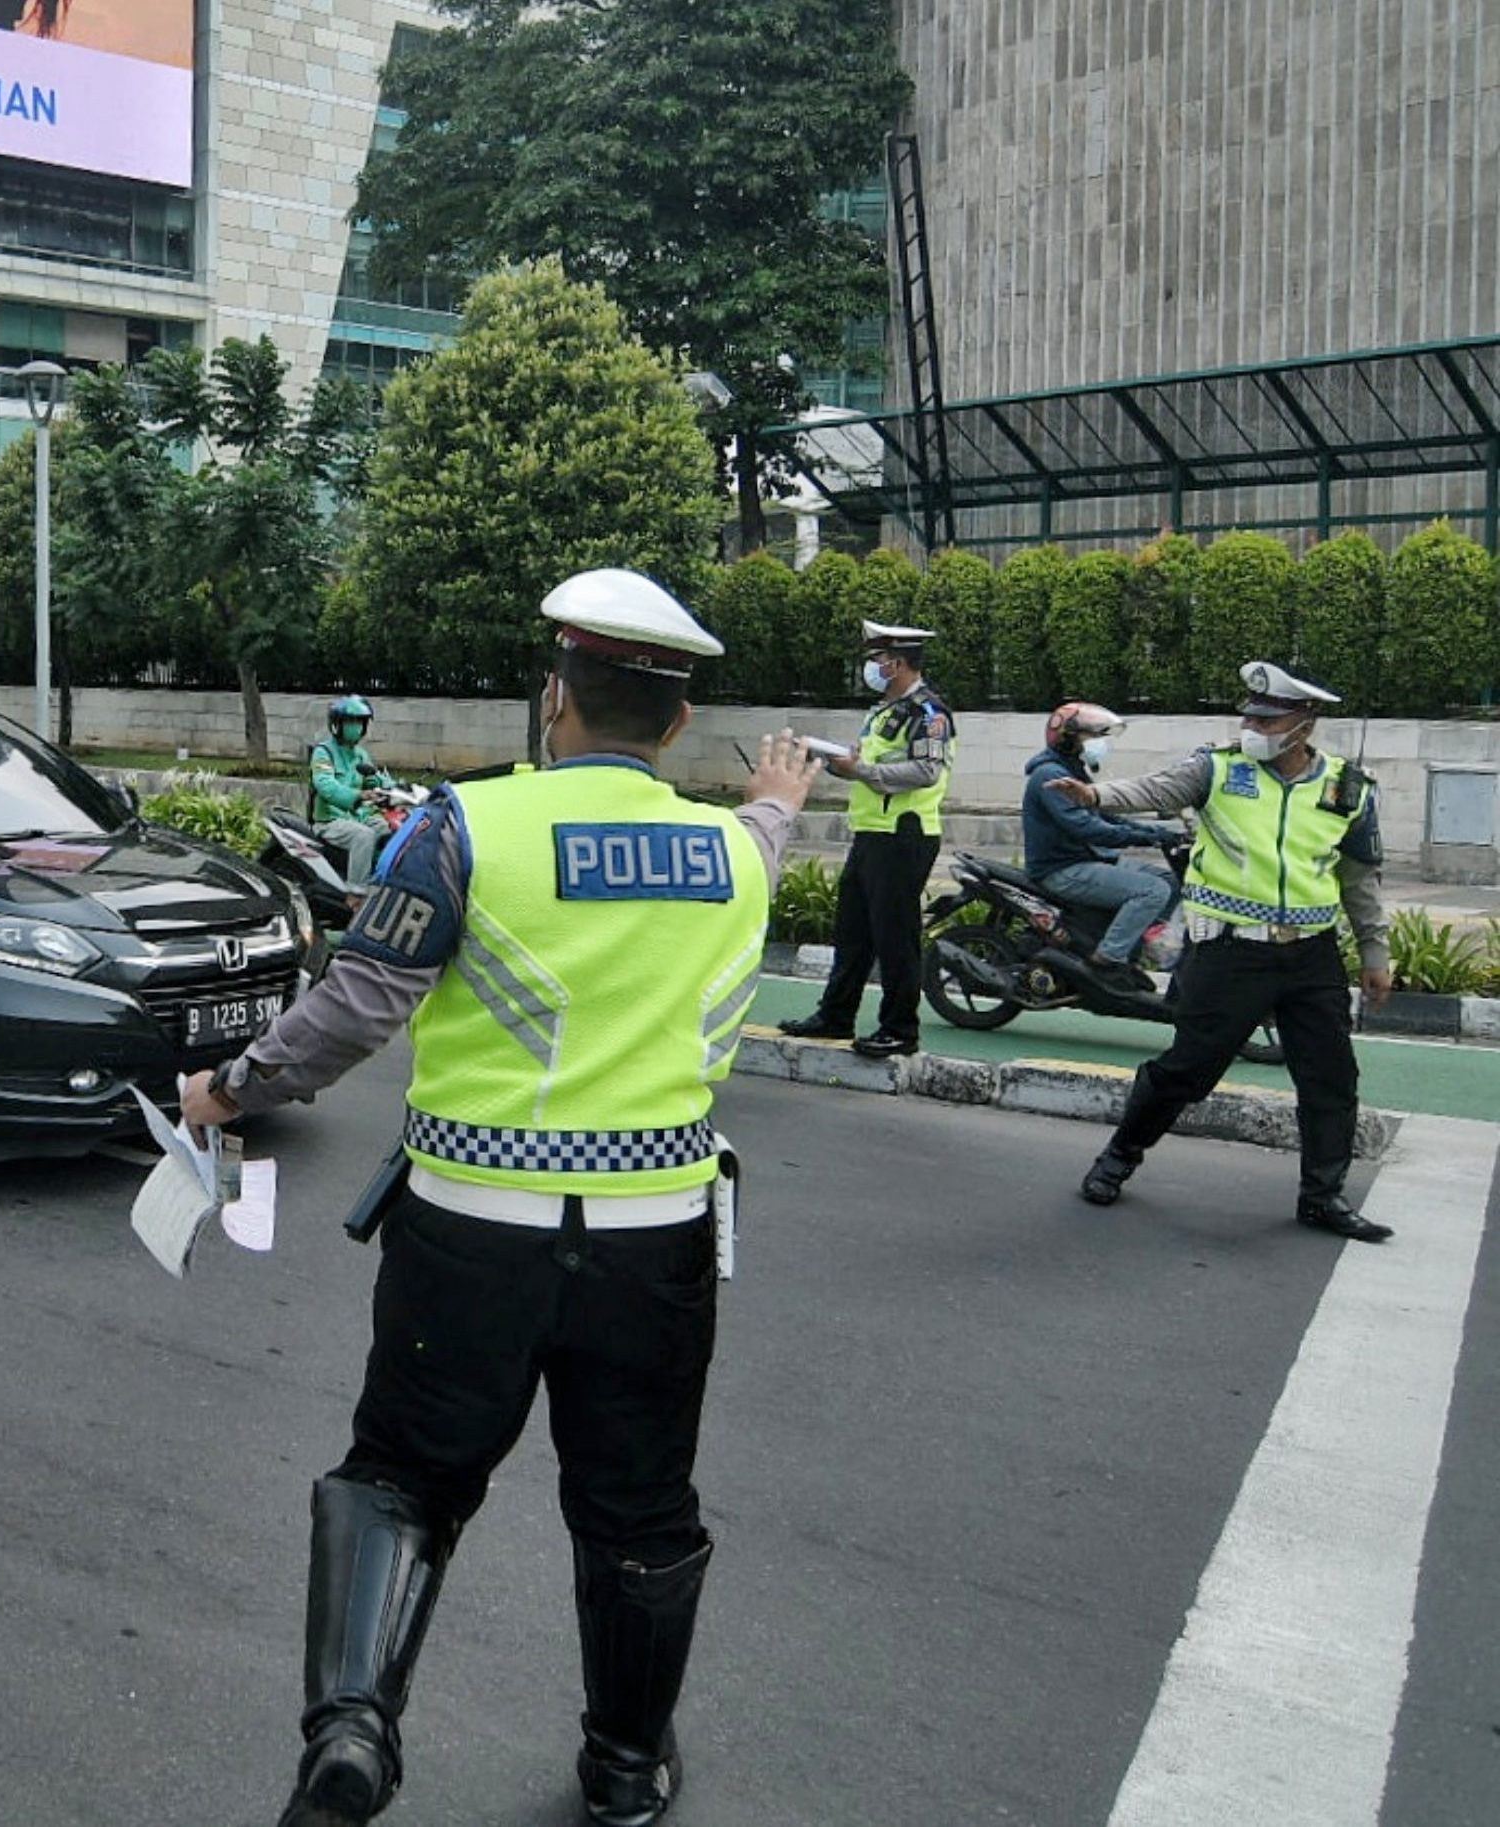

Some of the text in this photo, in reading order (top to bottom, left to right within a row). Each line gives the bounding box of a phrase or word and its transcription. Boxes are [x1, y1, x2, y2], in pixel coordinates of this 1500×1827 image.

[564, 834, 729, 887] POLISI
[189, 1008, 199, 1034] B
[212, 1002, 248, 1030] 1235
